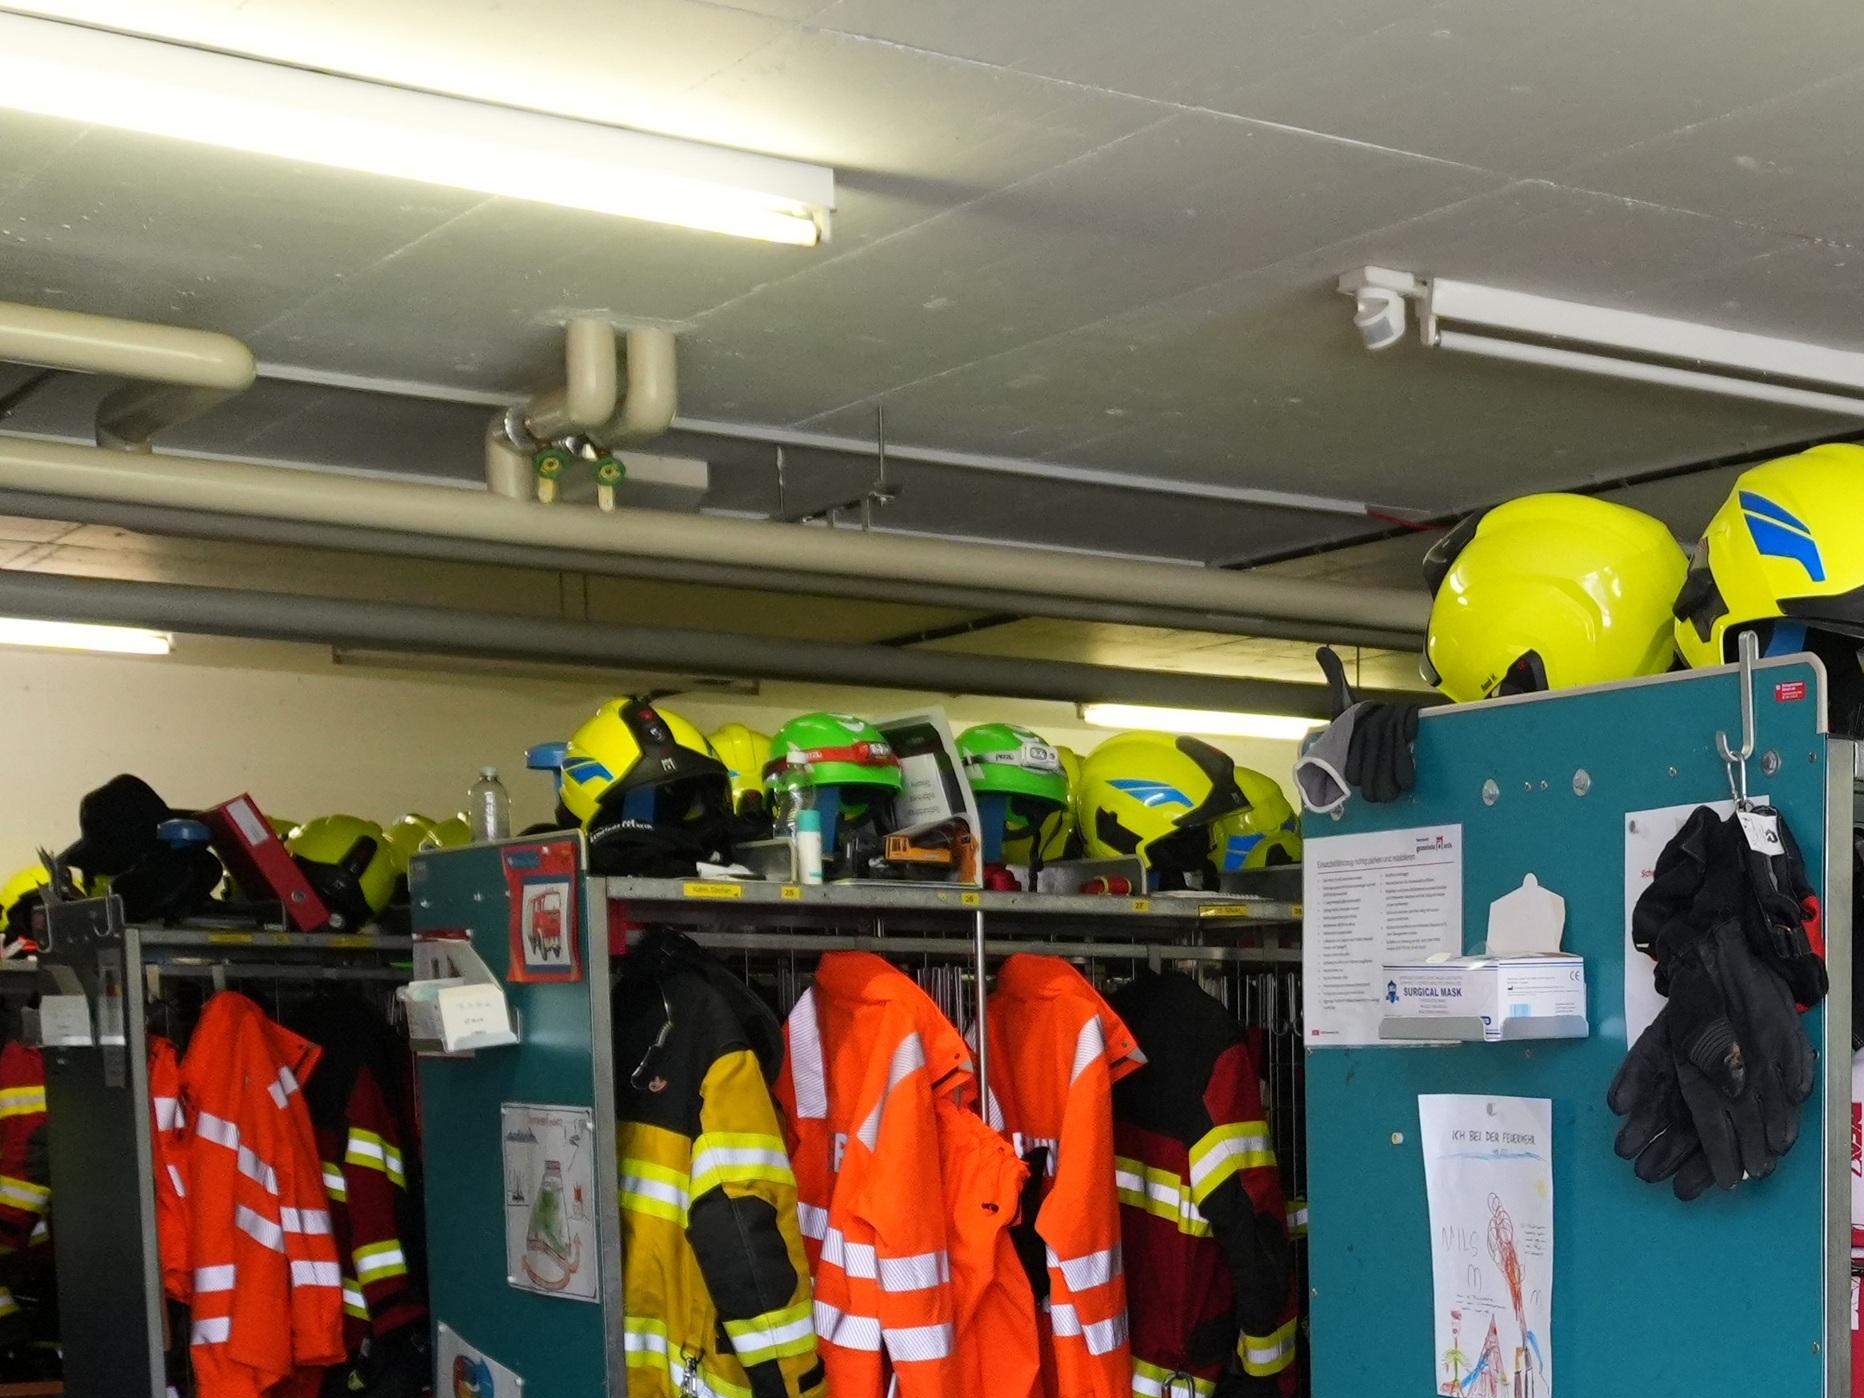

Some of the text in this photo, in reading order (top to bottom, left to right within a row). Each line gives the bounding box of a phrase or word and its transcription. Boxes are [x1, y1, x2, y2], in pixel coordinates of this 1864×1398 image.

[1403, 987, 1463, 997] SURGICAL MASK
[1452, 1129, 1466, 1141] ICH
[1469, 1130, 1482, 1142] BEI
[1485, 1131, 1499, 1142] DER
